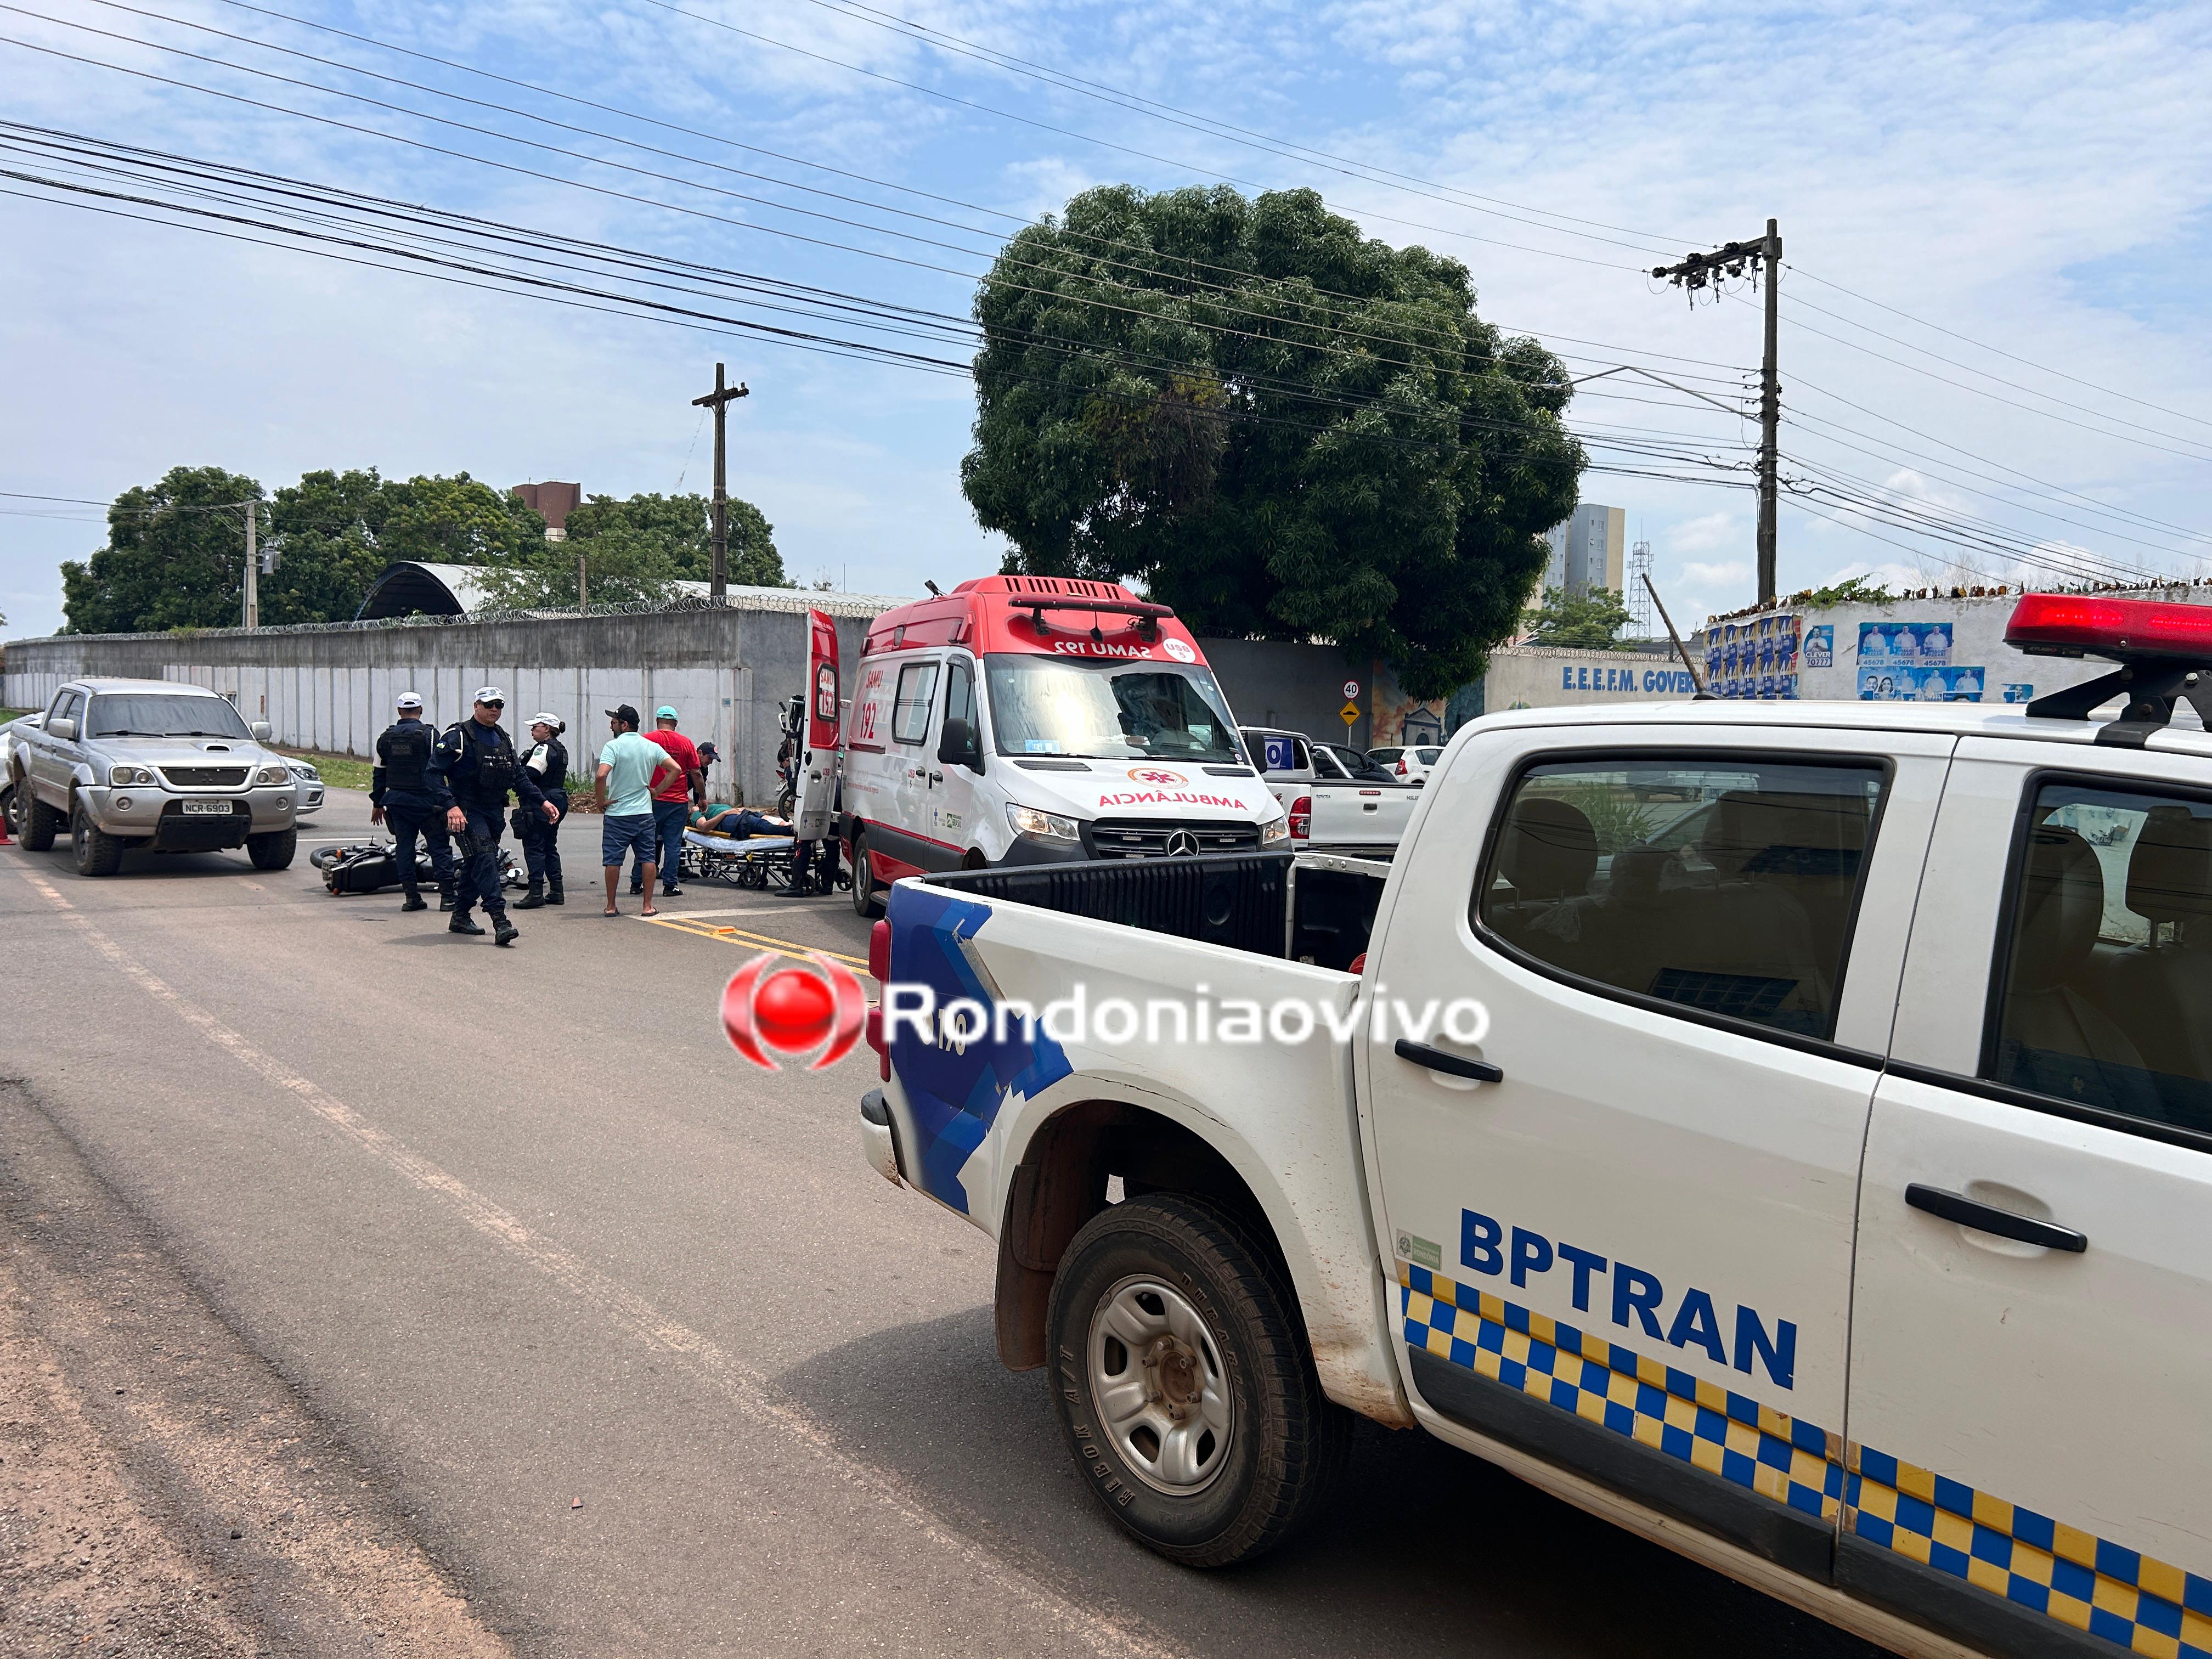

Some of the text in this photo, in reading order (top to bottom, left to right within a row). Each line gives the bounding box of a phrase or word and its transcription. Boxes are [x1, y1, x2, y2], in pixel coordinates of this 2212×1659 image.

[1728, 630, 1738, 647] 44
[1745, 626, 1756, 644] 44
[1763, 623, 1773, 642] 44
[1780, 619, 1793, 639] 44
[1711, 634, 1722, 651] 44
[821, 670, 833, 685] SAMU
[1711, 668, 1722, 685] 44
[1728, 665, 1738, 683] 44
[1744, 663, 1756, 681] 44
[1763, 661, 1774, 680] 44
[1780, 660, 1792, 679] 44
[866, 670, 884, 689] SAMU
[1346, 685, 1357, 693] 40
[1562, 667, 1699, 693] E.E.E.F.M. GOVER
[822, 691, 834, 715] 192
[860, 702, 877, 739] 192
[185, 804, 230, 812] NCR-6903
[1460, 1207, 1797, 1391] BPTRAN
[1060, 1345, 1135, 1506] REBOK A/T
